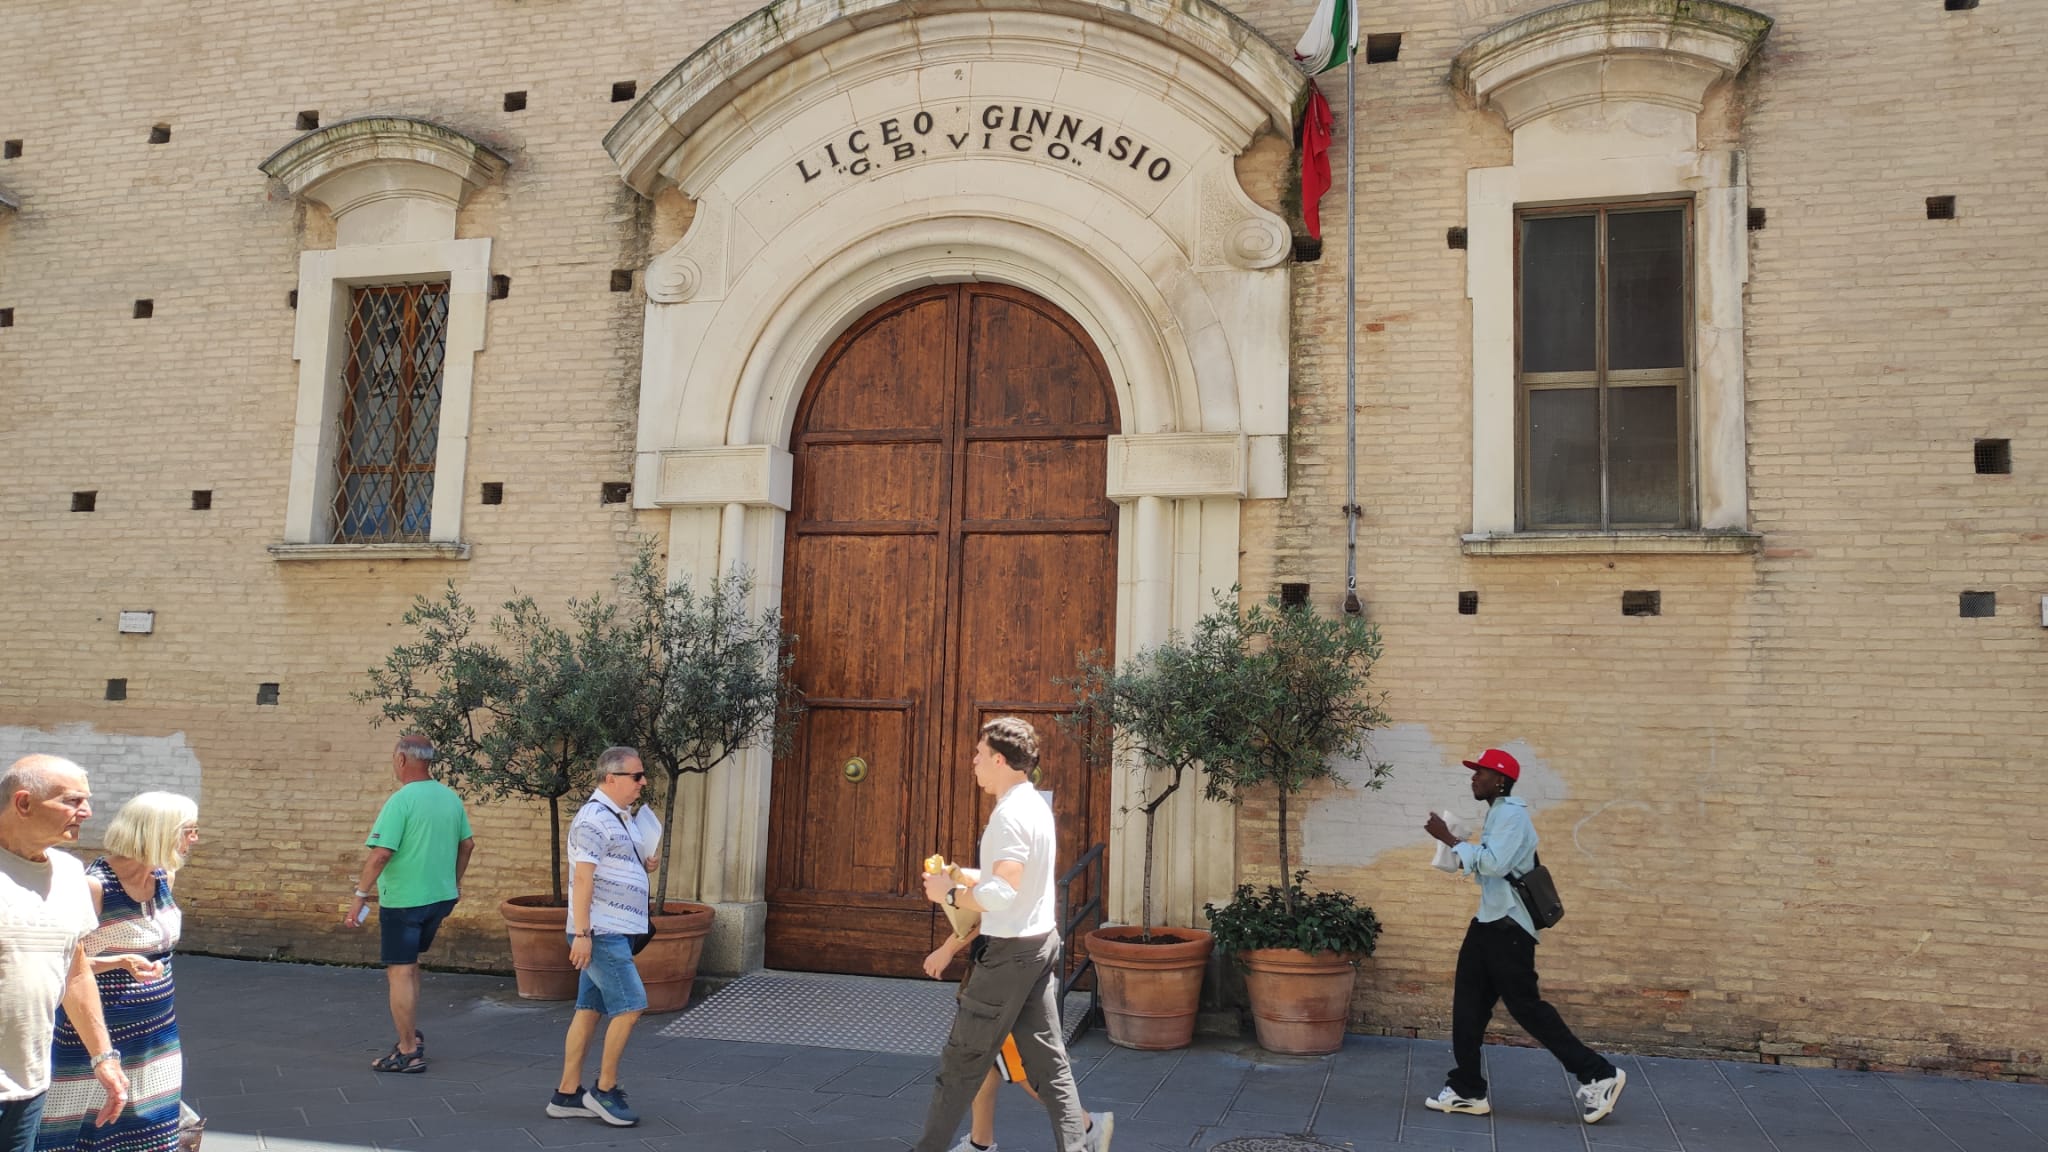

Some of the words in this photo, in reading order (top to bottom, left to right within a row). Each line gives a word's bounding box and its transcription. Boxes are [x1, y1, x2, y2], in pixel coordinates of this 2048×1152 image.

[795, 111, 933, 183] LICEO
[982, 105, 1171, 182] GINNASIO
[893, 142, 927, 161] B.
